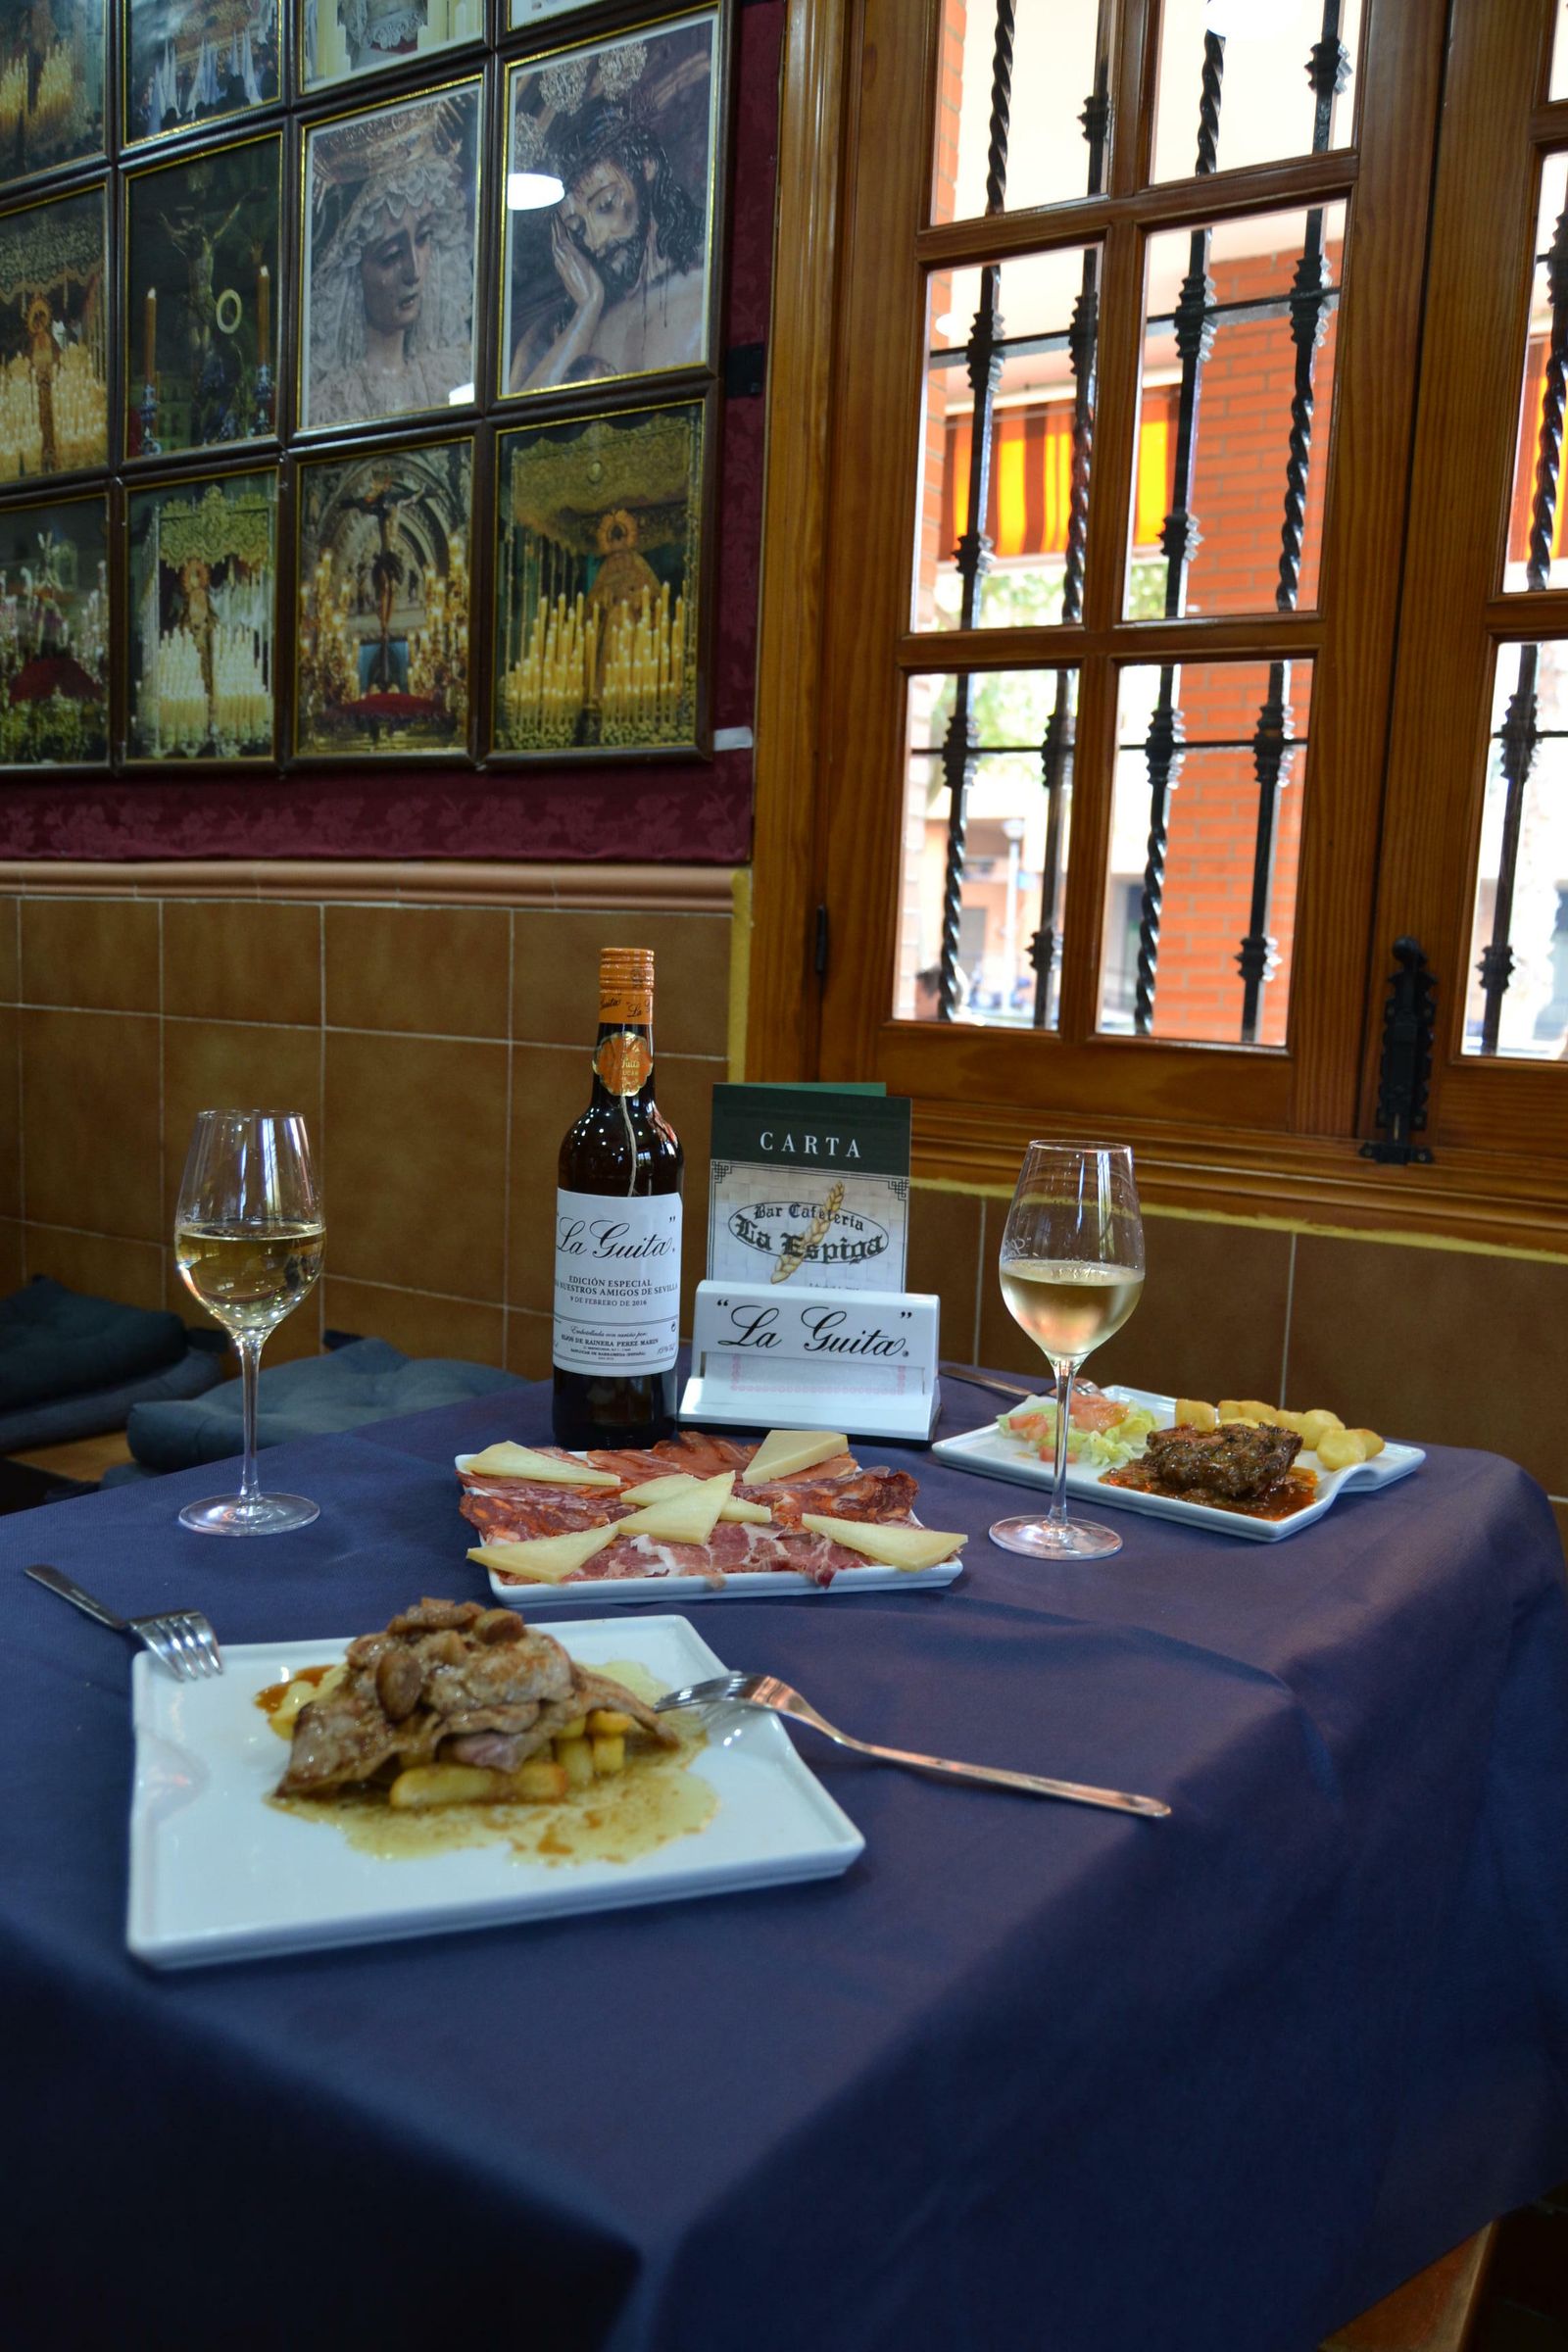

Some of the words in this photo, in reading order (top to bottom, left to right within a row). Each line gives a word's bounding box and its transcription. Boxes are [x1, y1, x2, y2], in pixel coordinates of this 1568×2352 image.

[760, 1131, 860, 1158] CARTA
[754, 1203, 783, 1219] Bar
[735, 1213, 773, 1251] La
[781, 1232, 885, 1265] Espiga
[568, 1275, 606, 1287] EDICIÓN
[608, 1278, 653, 1288] ESPECIAL
[599, 1288, 639, 1297] AMIGOS
[654, 1282, 678, 1294] SEVILLA
[584, 1298, 618, 1307] FEBRERO
